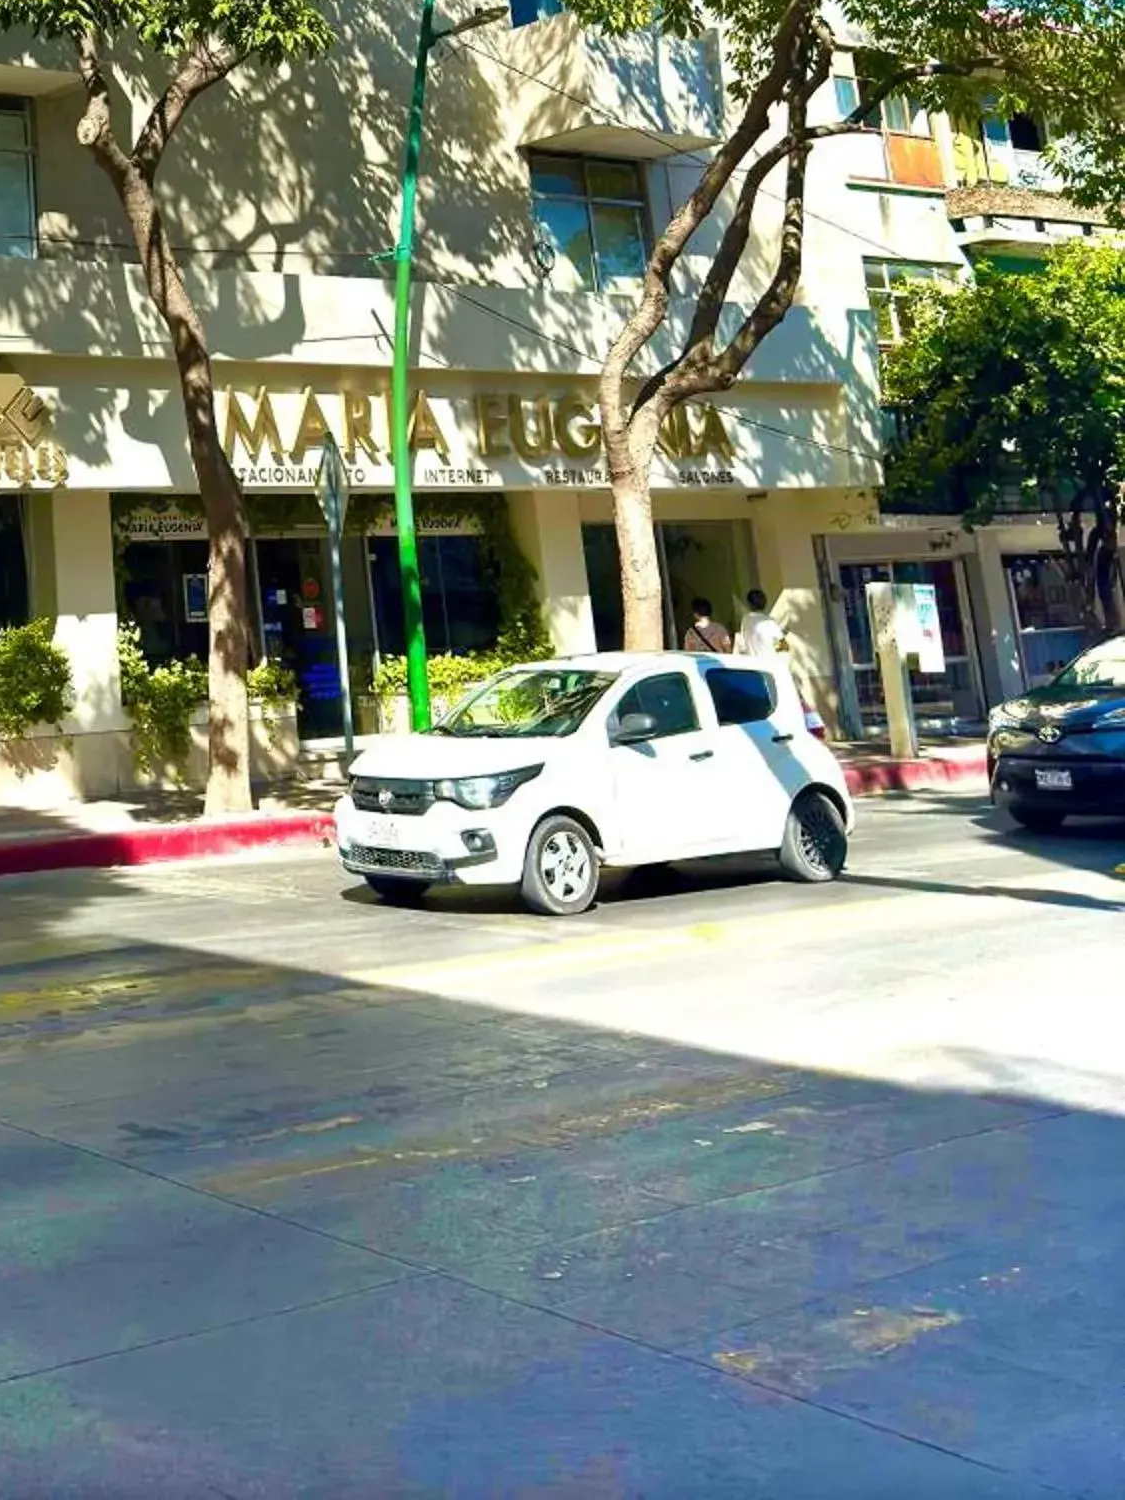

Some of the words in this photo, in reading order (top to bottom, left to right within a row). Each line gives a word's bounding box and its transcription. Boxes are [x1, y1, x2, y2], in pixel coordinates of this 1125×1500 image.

[477, 391, 738, 464] EUGNIA
[424, 468, 493, 484] INTERNET
[678, 470, 735, 485] SALONES
